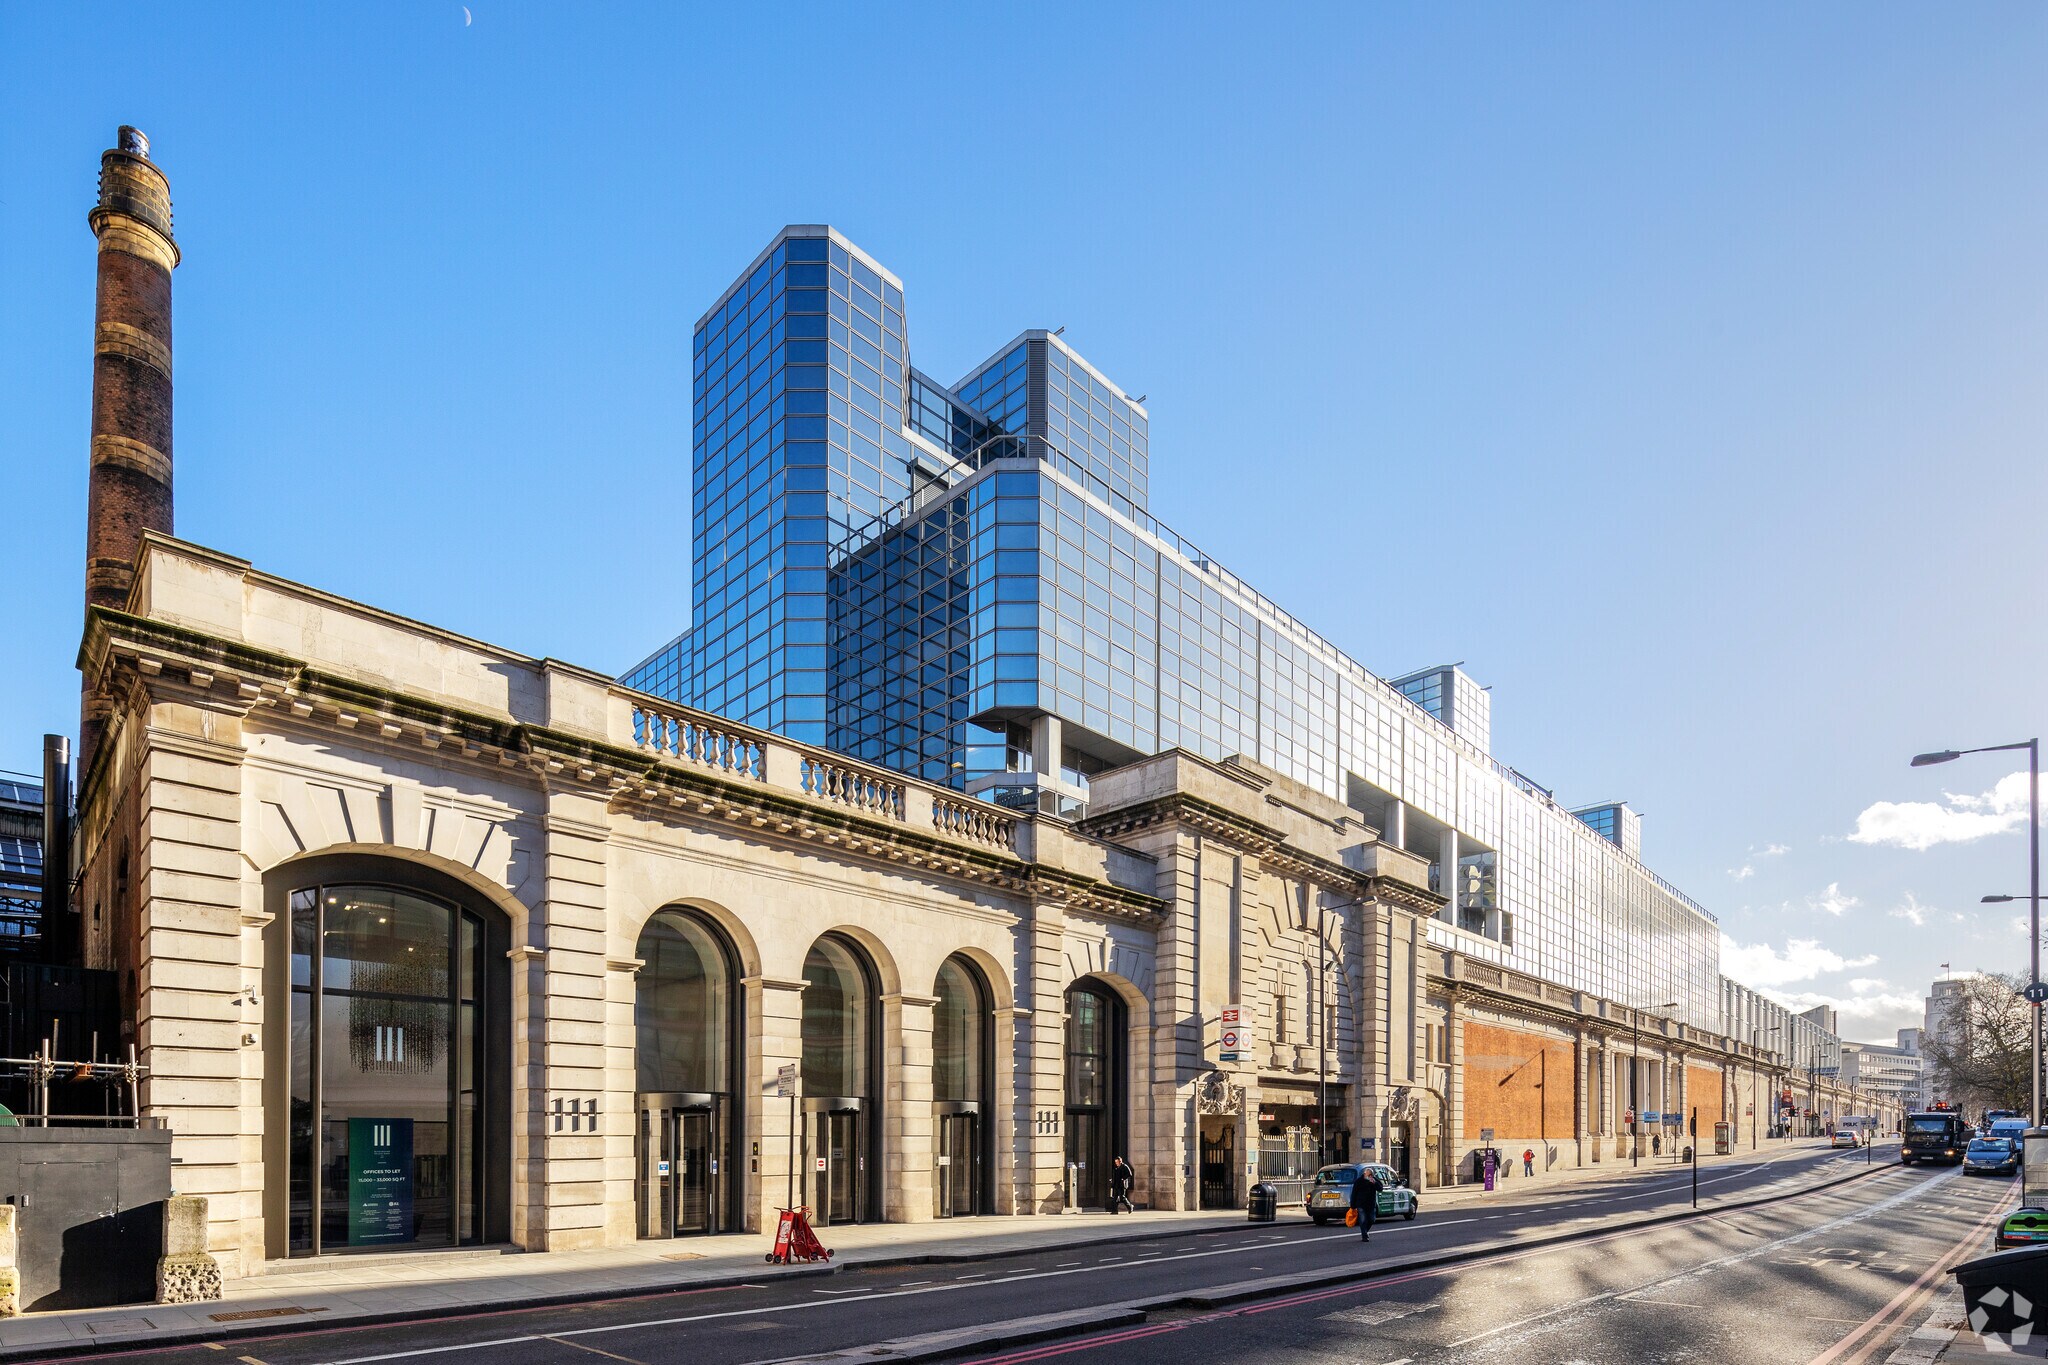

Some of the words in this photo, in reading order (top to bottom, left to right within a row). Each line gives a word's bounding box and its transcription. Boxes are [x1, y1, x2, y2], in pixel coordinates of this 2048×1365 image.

[2029, 988, 2043, 998] 11
[550, 1097, 597, 1133] 111
[1036, 1110, 1058, 1134] 111
[1769, 1256, 1911, 1274] BUS
